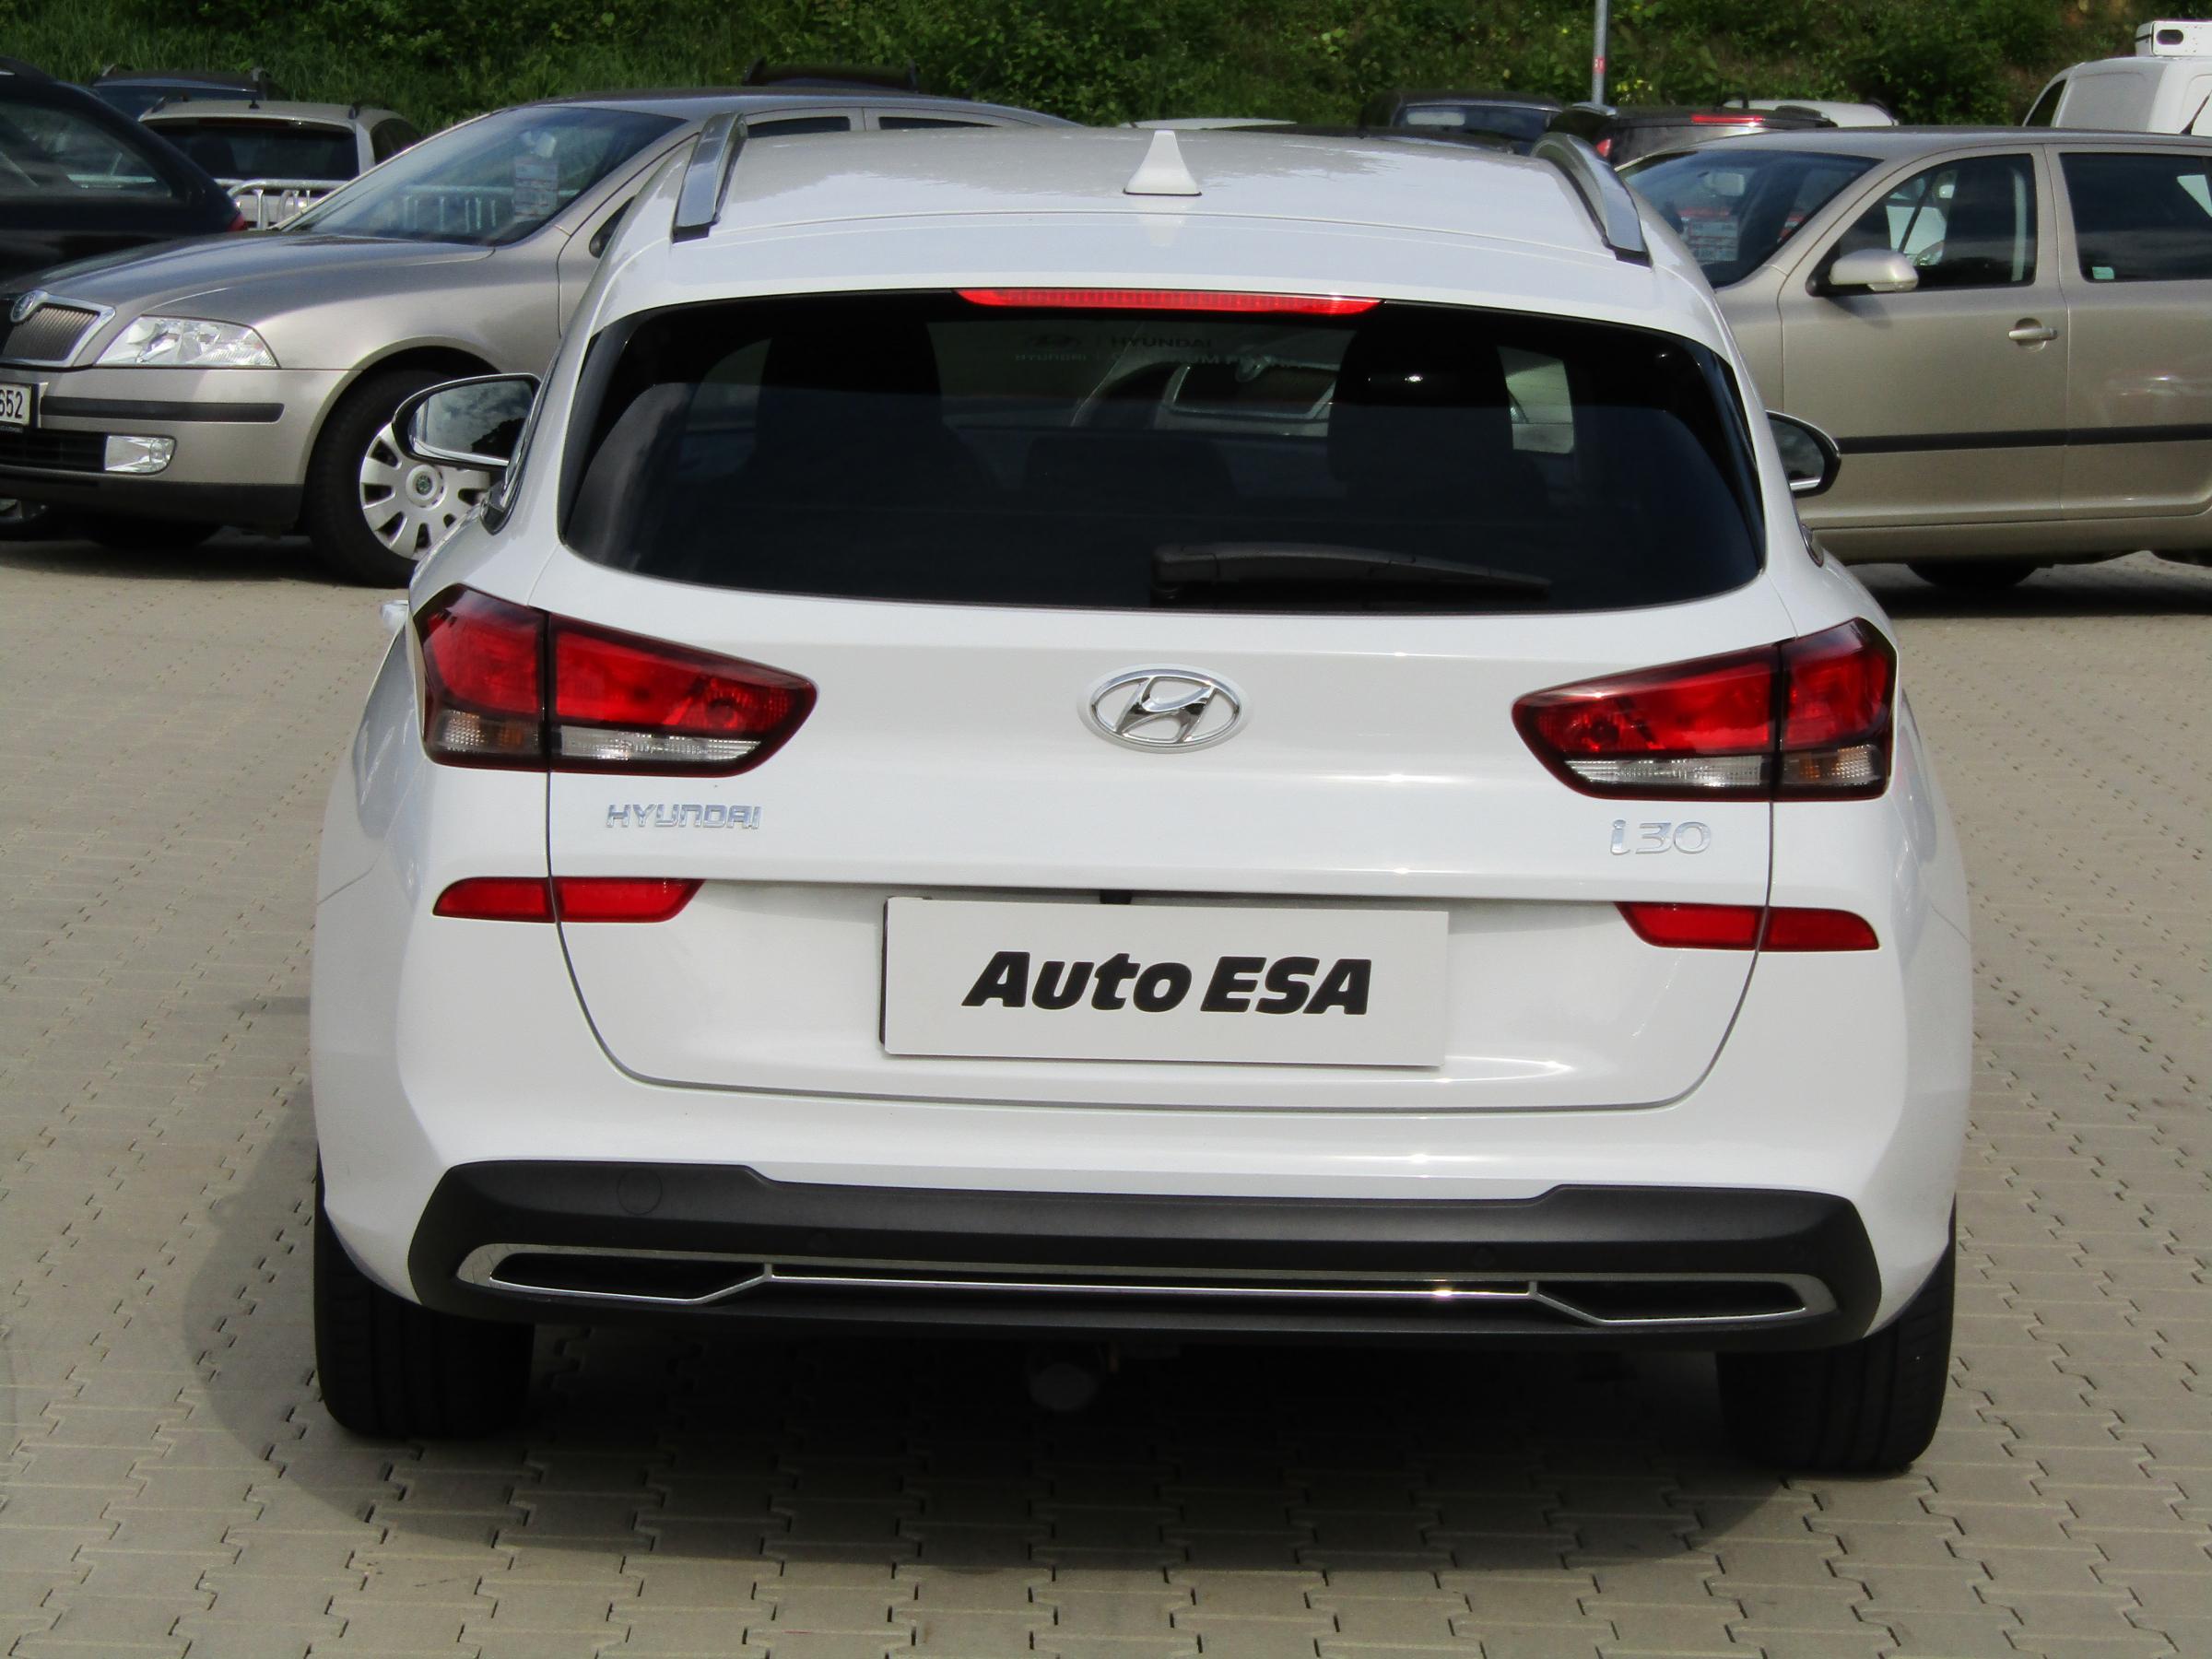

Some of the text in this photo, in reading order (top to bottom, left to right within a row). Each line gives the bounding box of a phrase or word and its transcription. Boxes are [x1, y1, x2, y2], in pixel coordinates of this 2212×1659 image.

[606, 804, 762, 830] HYUNDAI
[1610, 818, 1712, 855] i30
[961, 950, 1371, 1016] Auto ESA
